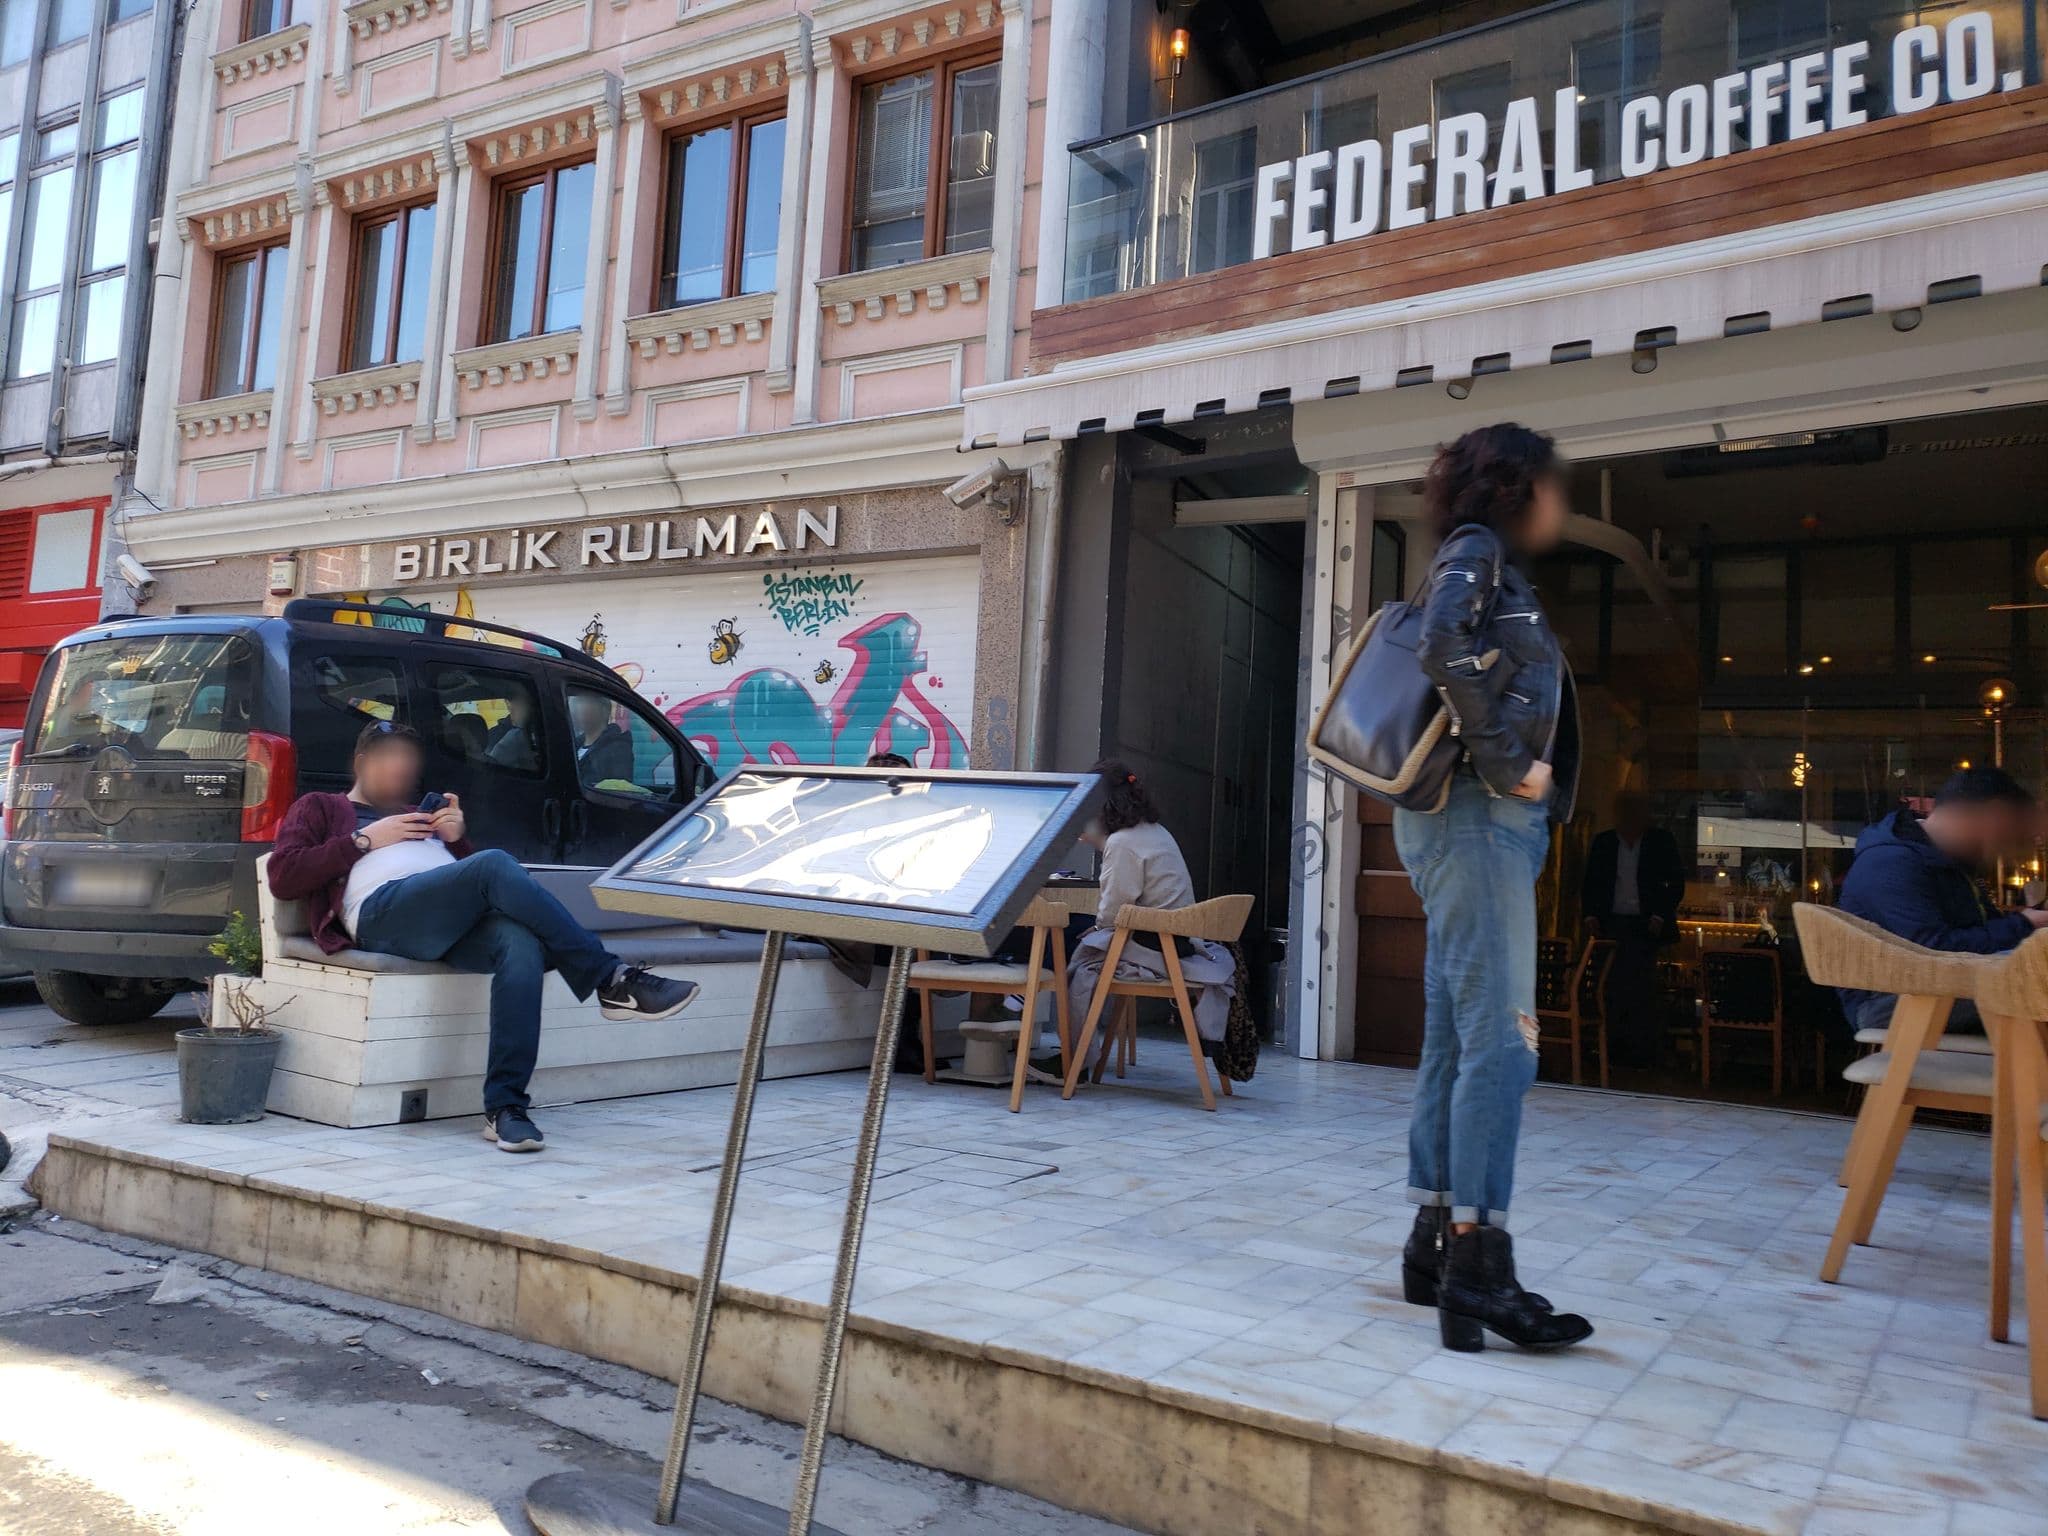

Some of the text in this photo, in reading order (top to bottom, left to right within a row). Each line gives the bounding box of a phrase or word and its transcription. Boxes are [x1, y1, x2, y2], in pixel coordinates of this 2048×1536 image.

[1253, 11, 2024, 260] FEDERAL COFFEE CO.
[393, 505, 838, 580] BİRLİK RULMAN
[19, 782, 54, 791] PEUGEOT
[183, 775, 227, 784] BIPPER
